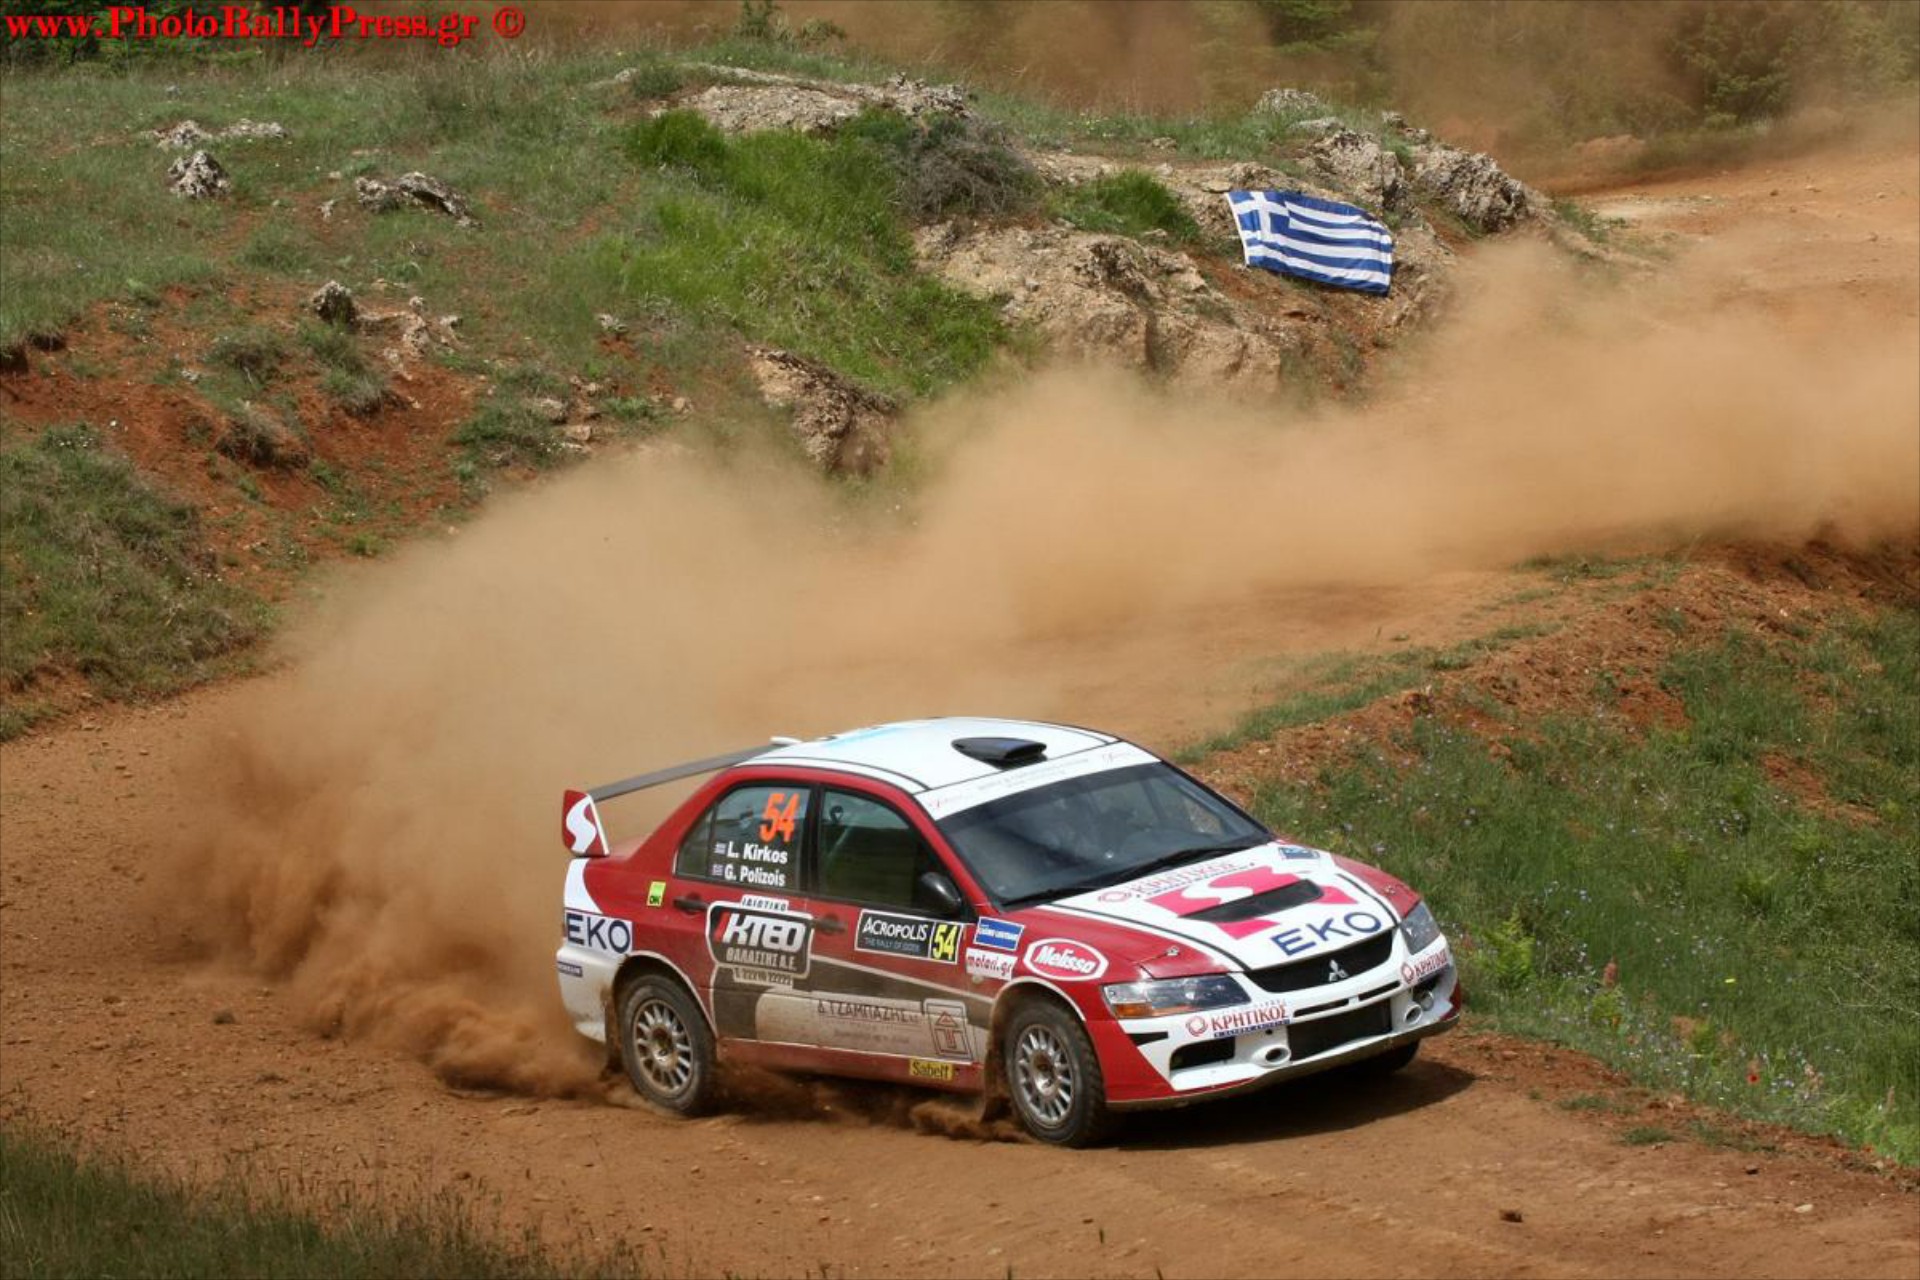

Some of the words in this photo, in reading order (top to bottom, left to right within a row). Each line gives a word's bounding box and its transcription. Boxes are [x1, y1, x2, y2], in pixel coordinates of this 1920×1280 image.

[759, 793, 799, 843] 54
[726, 841, 740, 859] L.
[743, 843, 788, 864] Kirkos
[724, 863, 737, 880] G.
[740, 866, 786, 887] Polizois
[566, 912, 631, 954] EKO
[862, 916, 928, 942] ACROPOLIS
[932, 924, 958, 961] 54
[1270, 912, 1382, 956] EKO
[1033, 945, 1098, 974] Melissa
[1211, 1003, 1288, 1031] ΚΡΗΤΙΚΟΣ
